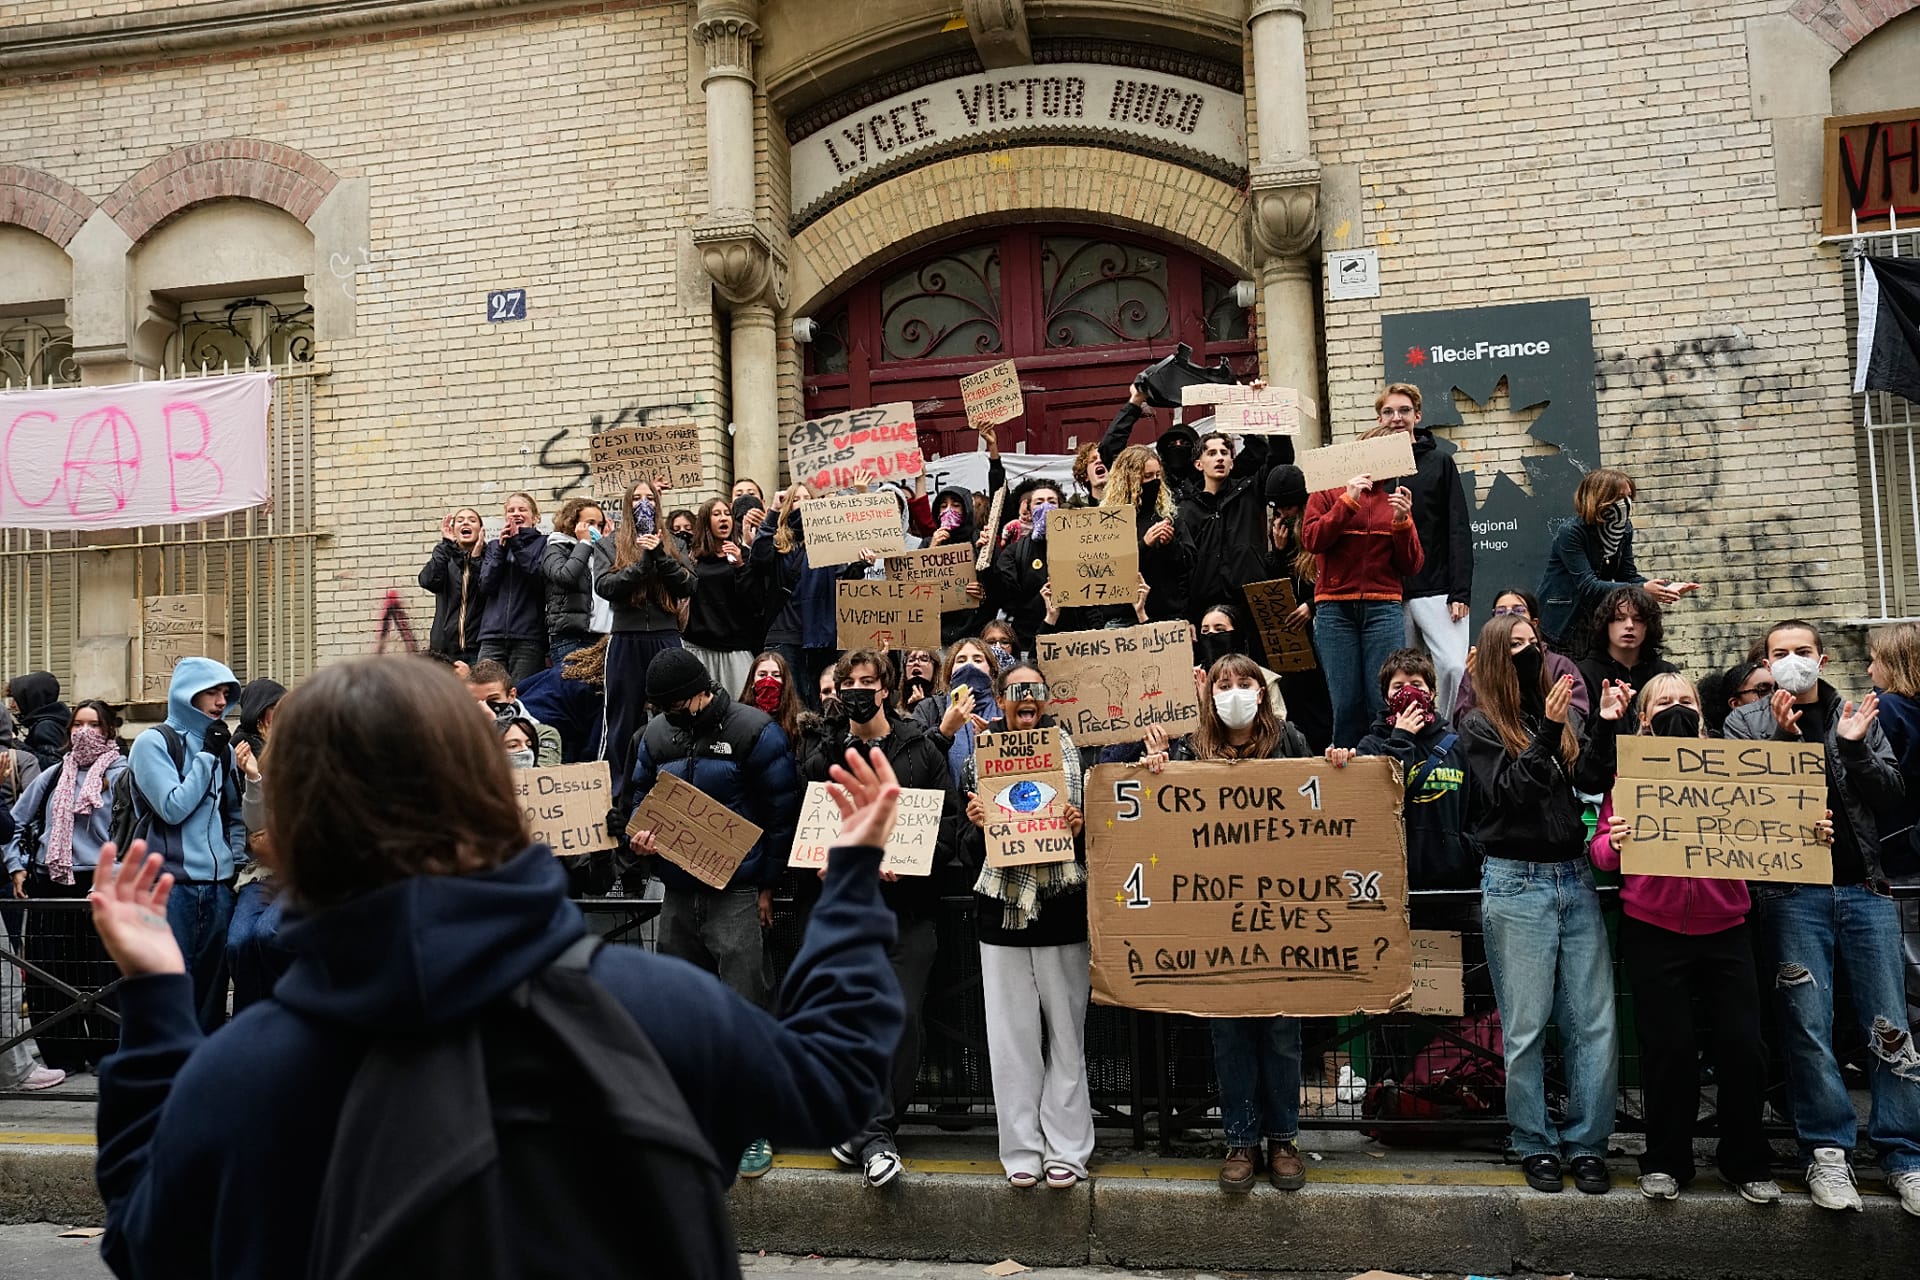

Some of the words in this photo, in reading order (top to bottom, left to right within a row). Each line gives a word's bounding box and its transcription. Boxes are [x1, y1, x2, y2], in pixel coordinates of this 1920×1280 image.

[957, 77, 1085, 126] VICTOR
[1109, 79, 1204, 135] HUGO
[492, 293, 520, 318] 27
[964, 382, 1003, 403] POUBELLES
[967, 403, 984, 416] FAIT
[985, 396, 1003, 410] PEUR
[789, 410, 899, 445] GAZEZ
[591, 434, 629, 449] C'EST
[634, 430, 662, 442] PLUS
[594, 452, 609, 461] DE
[792, 441, 828, 459] LES
[631, 456, 670, 469] DROITS
[796, 457, 829, 476] PAS
[807, 450, 923, 489] MINEURS
[680, 472, 701, 486] 1312
[864, 495, 896, 506] STEAKS
[804, 515, 832, 528] J'AIME
[833, 516, 845, 525] LA
[845, 508, 894, 523] PALESTINE
[1075, 512, 1097, 529] EST
[1470, 518, 1518, 535] égional
[836, 530, 855, 542] PAS
[855, 529, 872, 541] LES
[1480, 540, 1509, 551] Hugo
[889, 556, 914, 572] UNE
[921, 549, 972, 568] POUBELLE
[1078, 551, 1110, 562] QUAND
[907, 567, 955, 580] REMPLACE
[839, 583, 882, 598] FUCK
[889, 583, 905, 598] LE
[909, 584, 934, 600] 17
[1079, 583, 1107, 599] 17
[172, 602, 187, 612] de
[839, 608, 904, 625] VIVEMENT
[908, 609, 924, 623] LE
[869, 630, 894, 647] 17
[1040, 641, 1062, 661] JE
[1114, 636, 1138, 654] PAS
[976, 735, 994, 748] LA
[1001, 731, 1050, 746] POLICE
[1000, 745, 1035, 758] NOUS
[1677, 747, 1730, 777] DE
[1113, 779, 1142, 821] 5
[1157, 783, 1207, 814] CRS
[1219, 785, 1286, 812] POUR
[1297, 775, 1321, 811] 1
[1635, 783, 1776, 817] FRANÇAIS
[1787, 788, 1820, 810] +
[665, 782, 740, 839] FUCK
[807, 806, 820, 823] À
[800, 827, 825, 840] ET
[989, 824, 1012, 840] ÇA
[1192, 817, 1357, 850] MANIFESTANT
[1632, 814, 1680, 842] DE
[1696, 817, 1794, 847] PROFS
[644, 809, 736, 879] TRUMP
[1002, 840, 1026, 856] LES
[1034, 837, 1073, 852] YEUX
[1685, 845, 1803, 877] FRANÇAIS
[1122, 863, 1151, 908] 1
[1173, 873, 1244, 902] PROF
[1258, 874, 1342, 902] POUR
[1342, 870, 1382, 901] 36
[1231, 902, 1333, 933] ÉLÈVES
[1124, 940, 1144, 973] À
[1155, 947, 1197, 972] QUI
[1205, 945, 1238, 968] VA
[1240, 940, 1270, 965] LA
[1281, 943, 1359, 972] PRIME
[1373, 936, 1391, 972] ?
